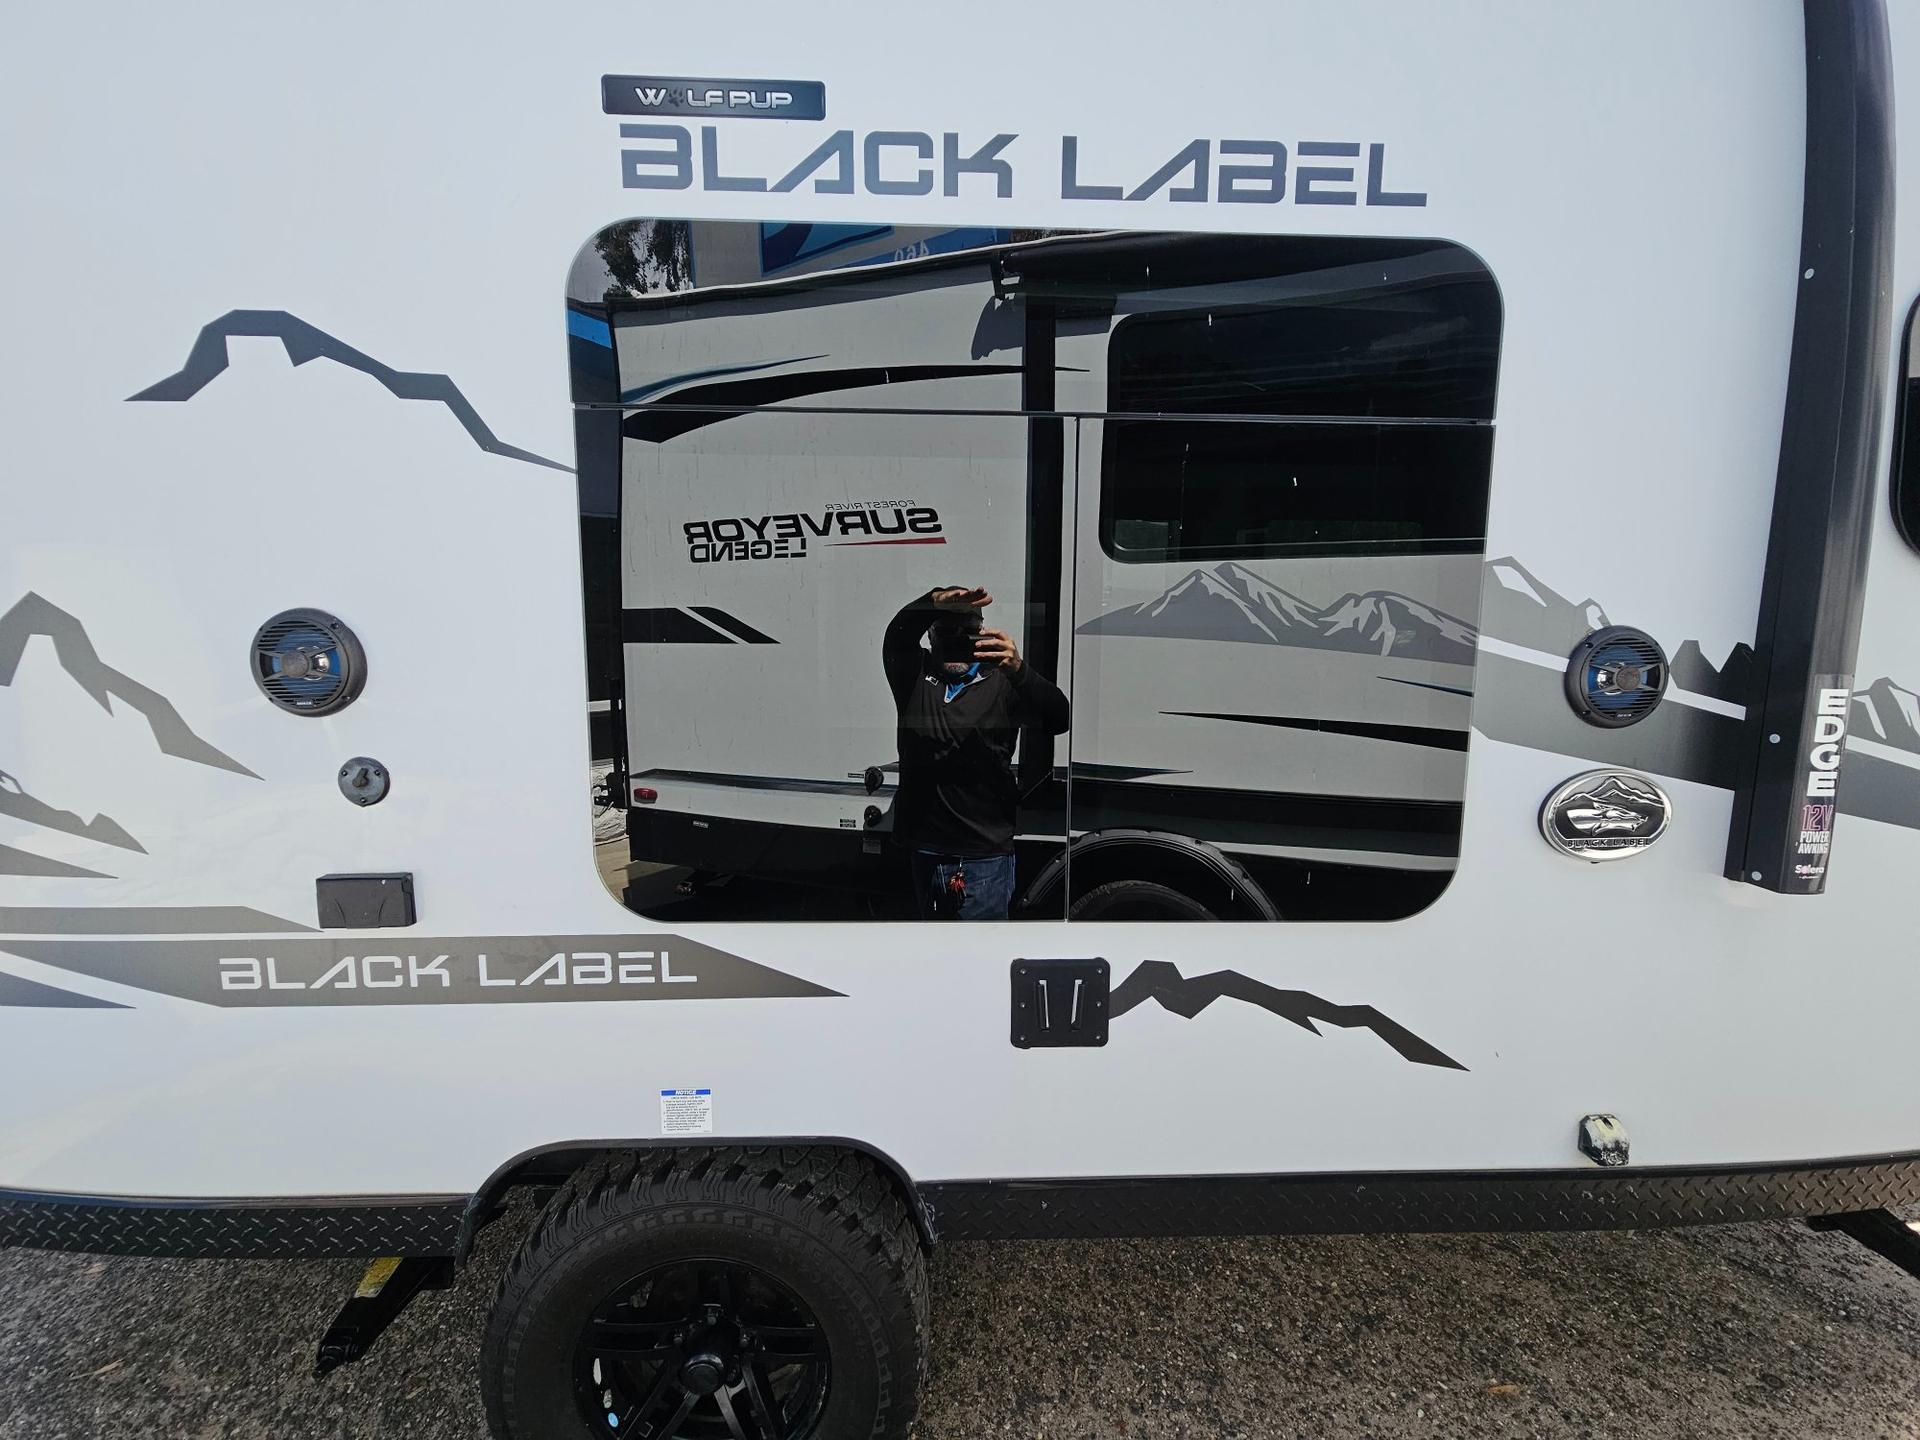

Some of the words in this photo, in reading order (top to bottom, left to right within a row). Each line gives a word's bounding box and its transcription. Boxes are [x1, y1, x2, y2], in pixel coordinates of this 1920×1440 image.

[729, 89, 793, 109] PUP
[619, 123, 1019, 198] BLACK
[1062, 134, 1427, 207] LABEL
[1806, 688, 1849, 797] EDGE
[1803, 805, 1833, 830] 12V
[1567, 839, 1608, 849] BLACK
[1613, 838, 1651, 848] LABEL
[1800, 831, 1829, 842] POWER
[219, 954, 450, 990] BLACK
[479, 951, 697, 986] LABEL
